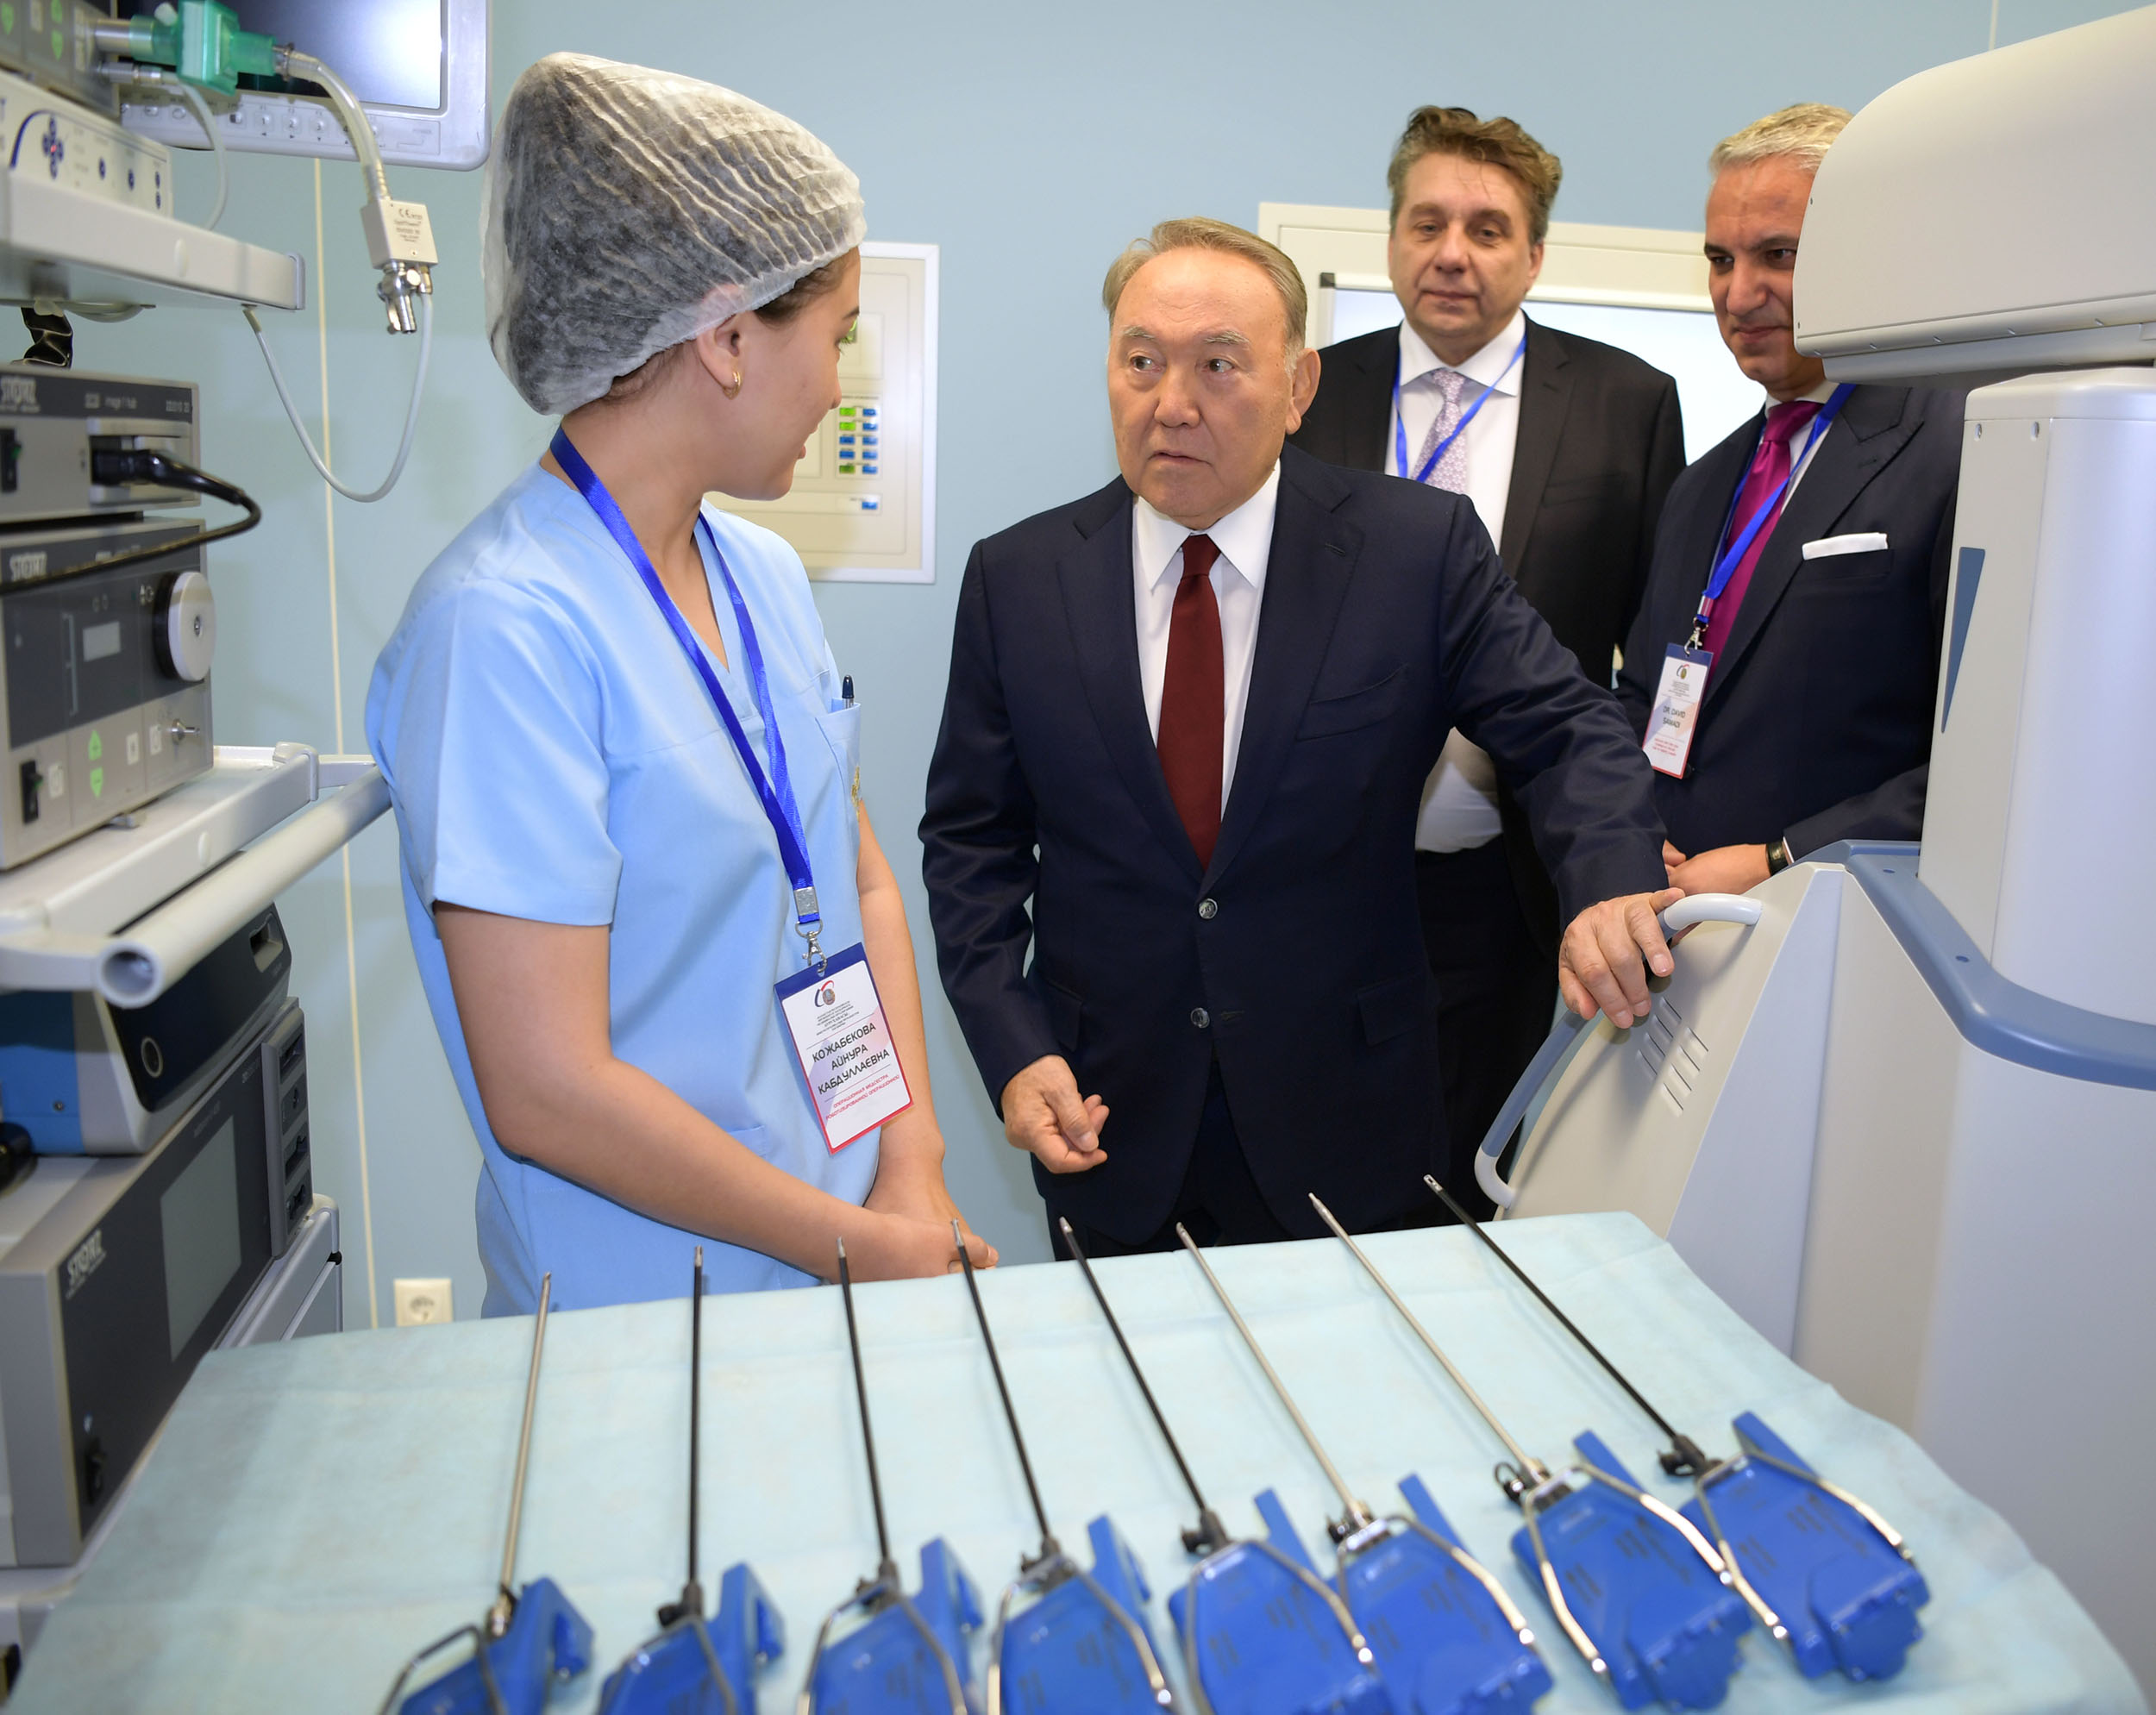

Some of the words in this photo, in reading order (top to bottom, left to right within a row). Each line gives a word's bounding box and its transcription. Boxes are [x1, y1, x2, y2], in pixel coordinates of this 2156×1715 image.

[812, 1023, 876, 1062] КОЖАБЕКОВА
[831, 1044, 868, 1070] АЙНУРА
[818, 1049, 890, 1094] КАБДУЛЛАЕВНА
[67, 1229, 103, 1286] STORZ
